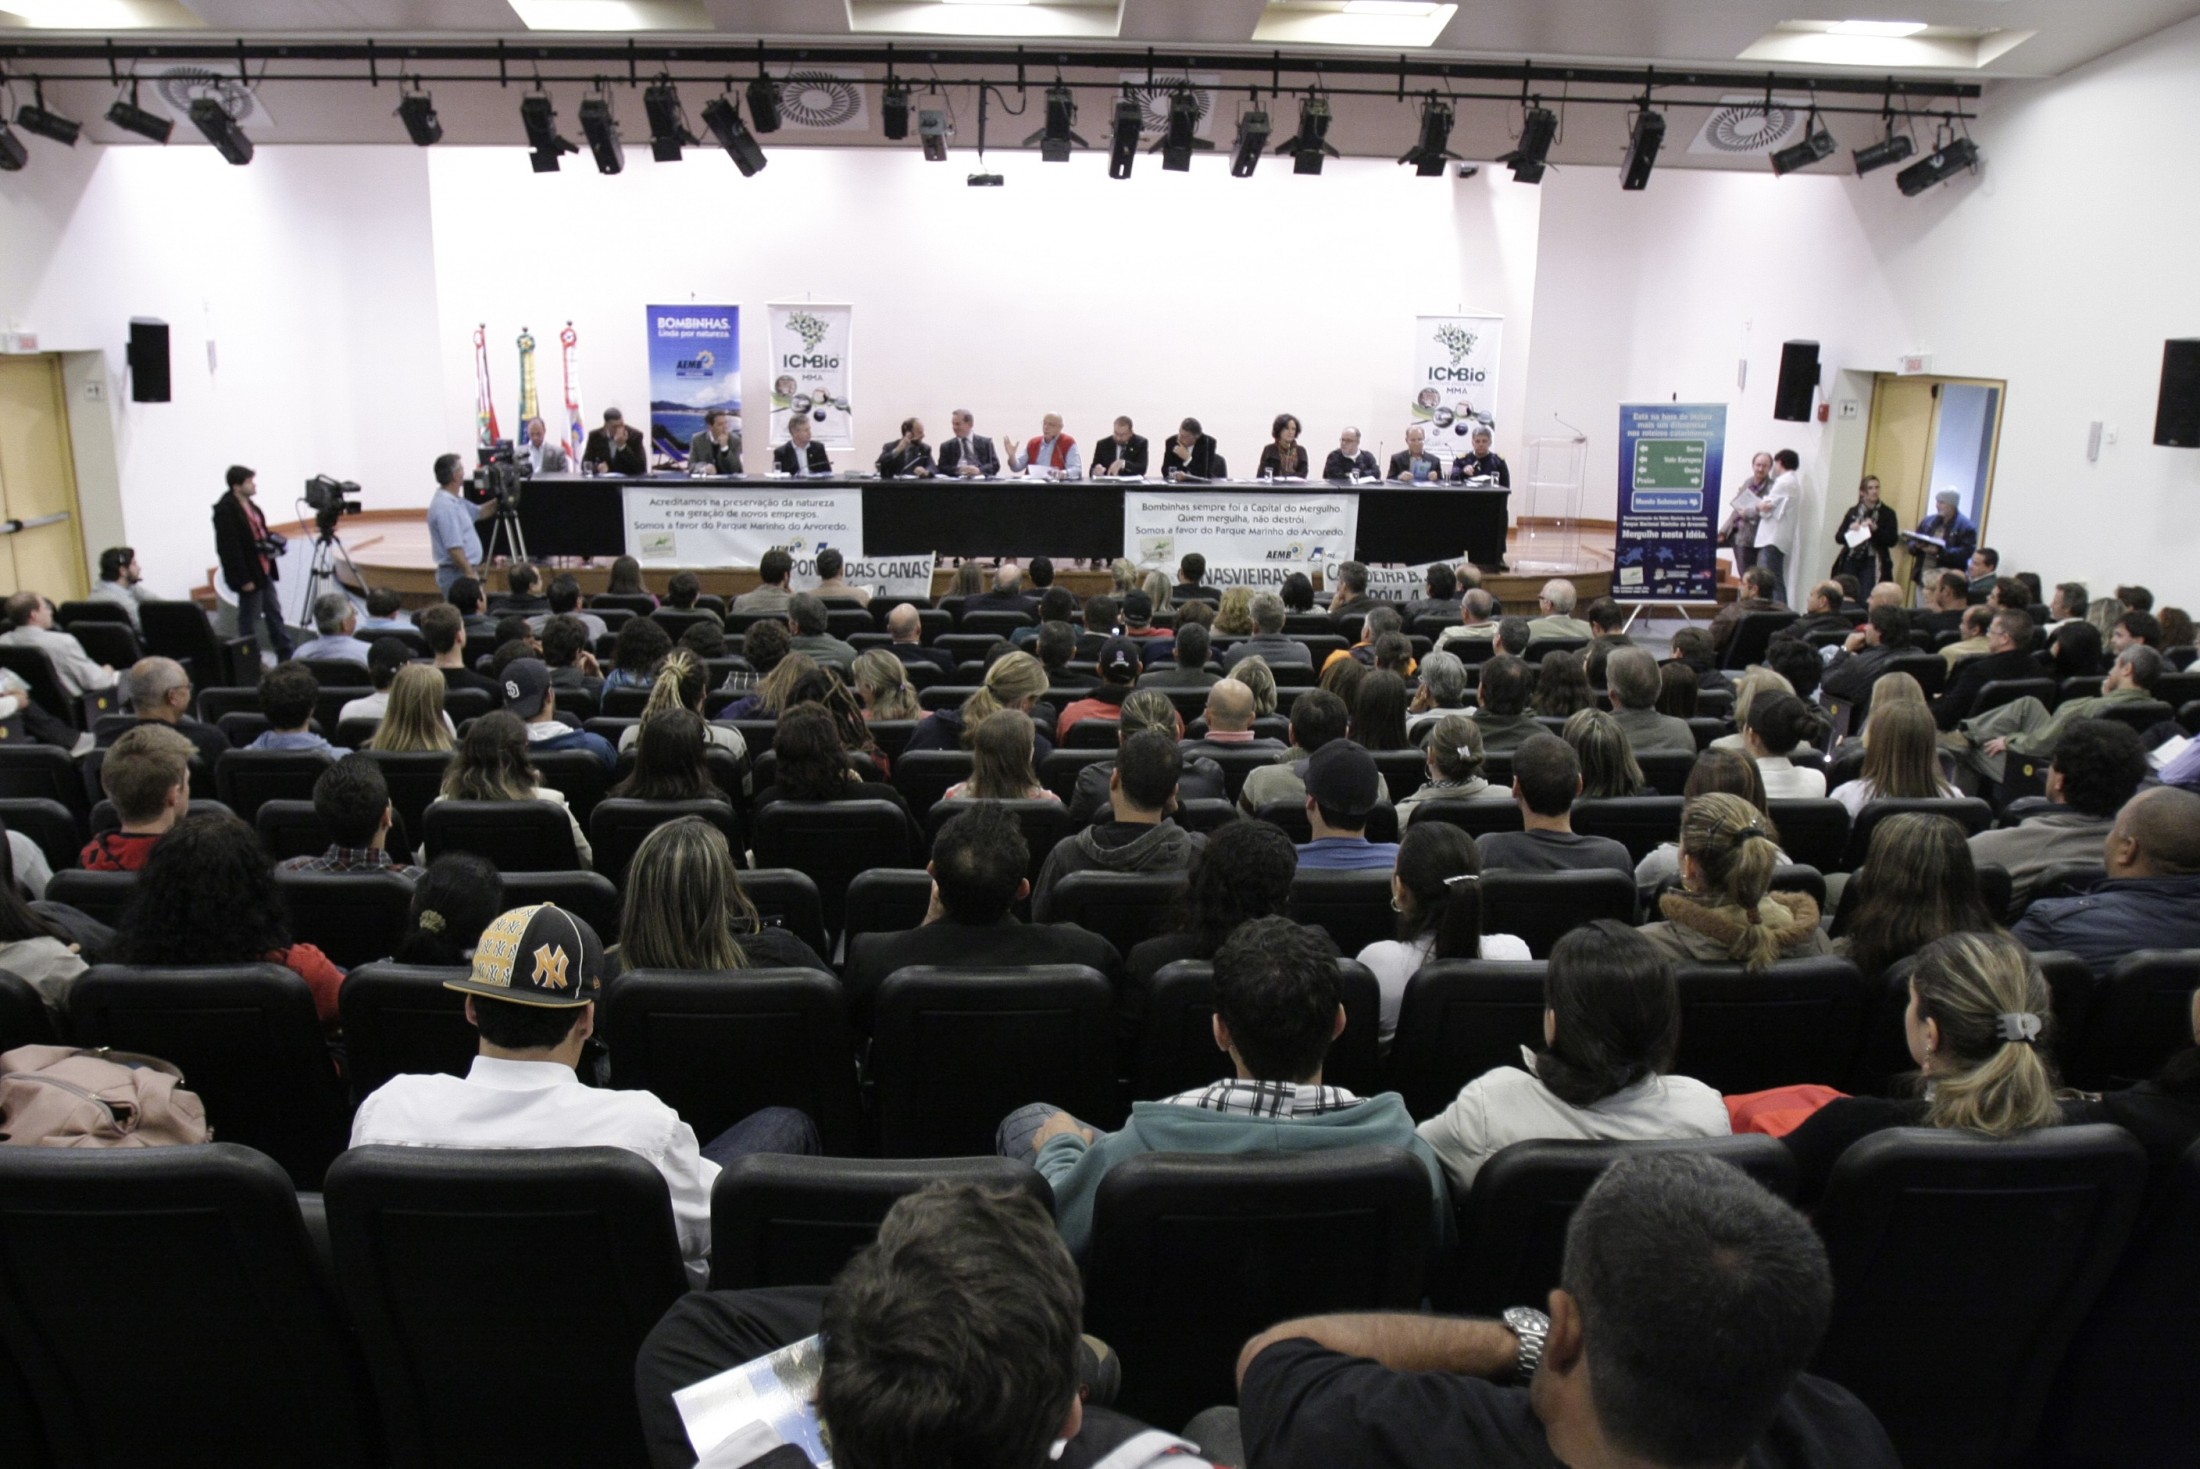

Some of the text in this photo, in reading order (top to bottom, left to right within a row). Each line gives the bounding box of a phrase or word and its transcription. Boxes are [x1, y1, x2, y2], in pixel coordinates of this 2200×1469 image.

[784, 354, 839, 368] ICMBio
[1428, 366, 1486, 382] ICMBio
[723, 499, 779, 509] preservação
[782, 498, 794, 506] da
[1142, 503, 1190, 511] Bombinhas
[1192, 504, 1226, 512] sempre
[1228, 504, 1240, 512] foi
[1251, 504, 1282, 513] Capital
[1284, 504, 1297, 512] do
[1300, 505, 1342, 514] Mergulho.
[688, 510, 724, 519] geração
[1178, 514, 1204, 522] Quem
[1206, 515, 1250, 524] mergulha,
[634, 521, 664, 530] Somos
[676, 521, 698, 530] favor
[701, 522, 714, 530] do
[716, 522, 747, 531] Parque
[750, 522, 786, 530] Marinho
[788, 522, 800, 530] do
[1136, 526, 1166, 534] Somos
[1176, 526, 1198, 534] favor
[1200, 526, 1213, 534] do
[1216, 526, 1246, 536] Parque
[1286, 528, 1300, 536] do
[1266, 550, 1292, 559] AEMB
[844, 562, 876, 578] DAS
[878, 561, 930, 578] CANAS
[532, 942, 570, 989] NY
